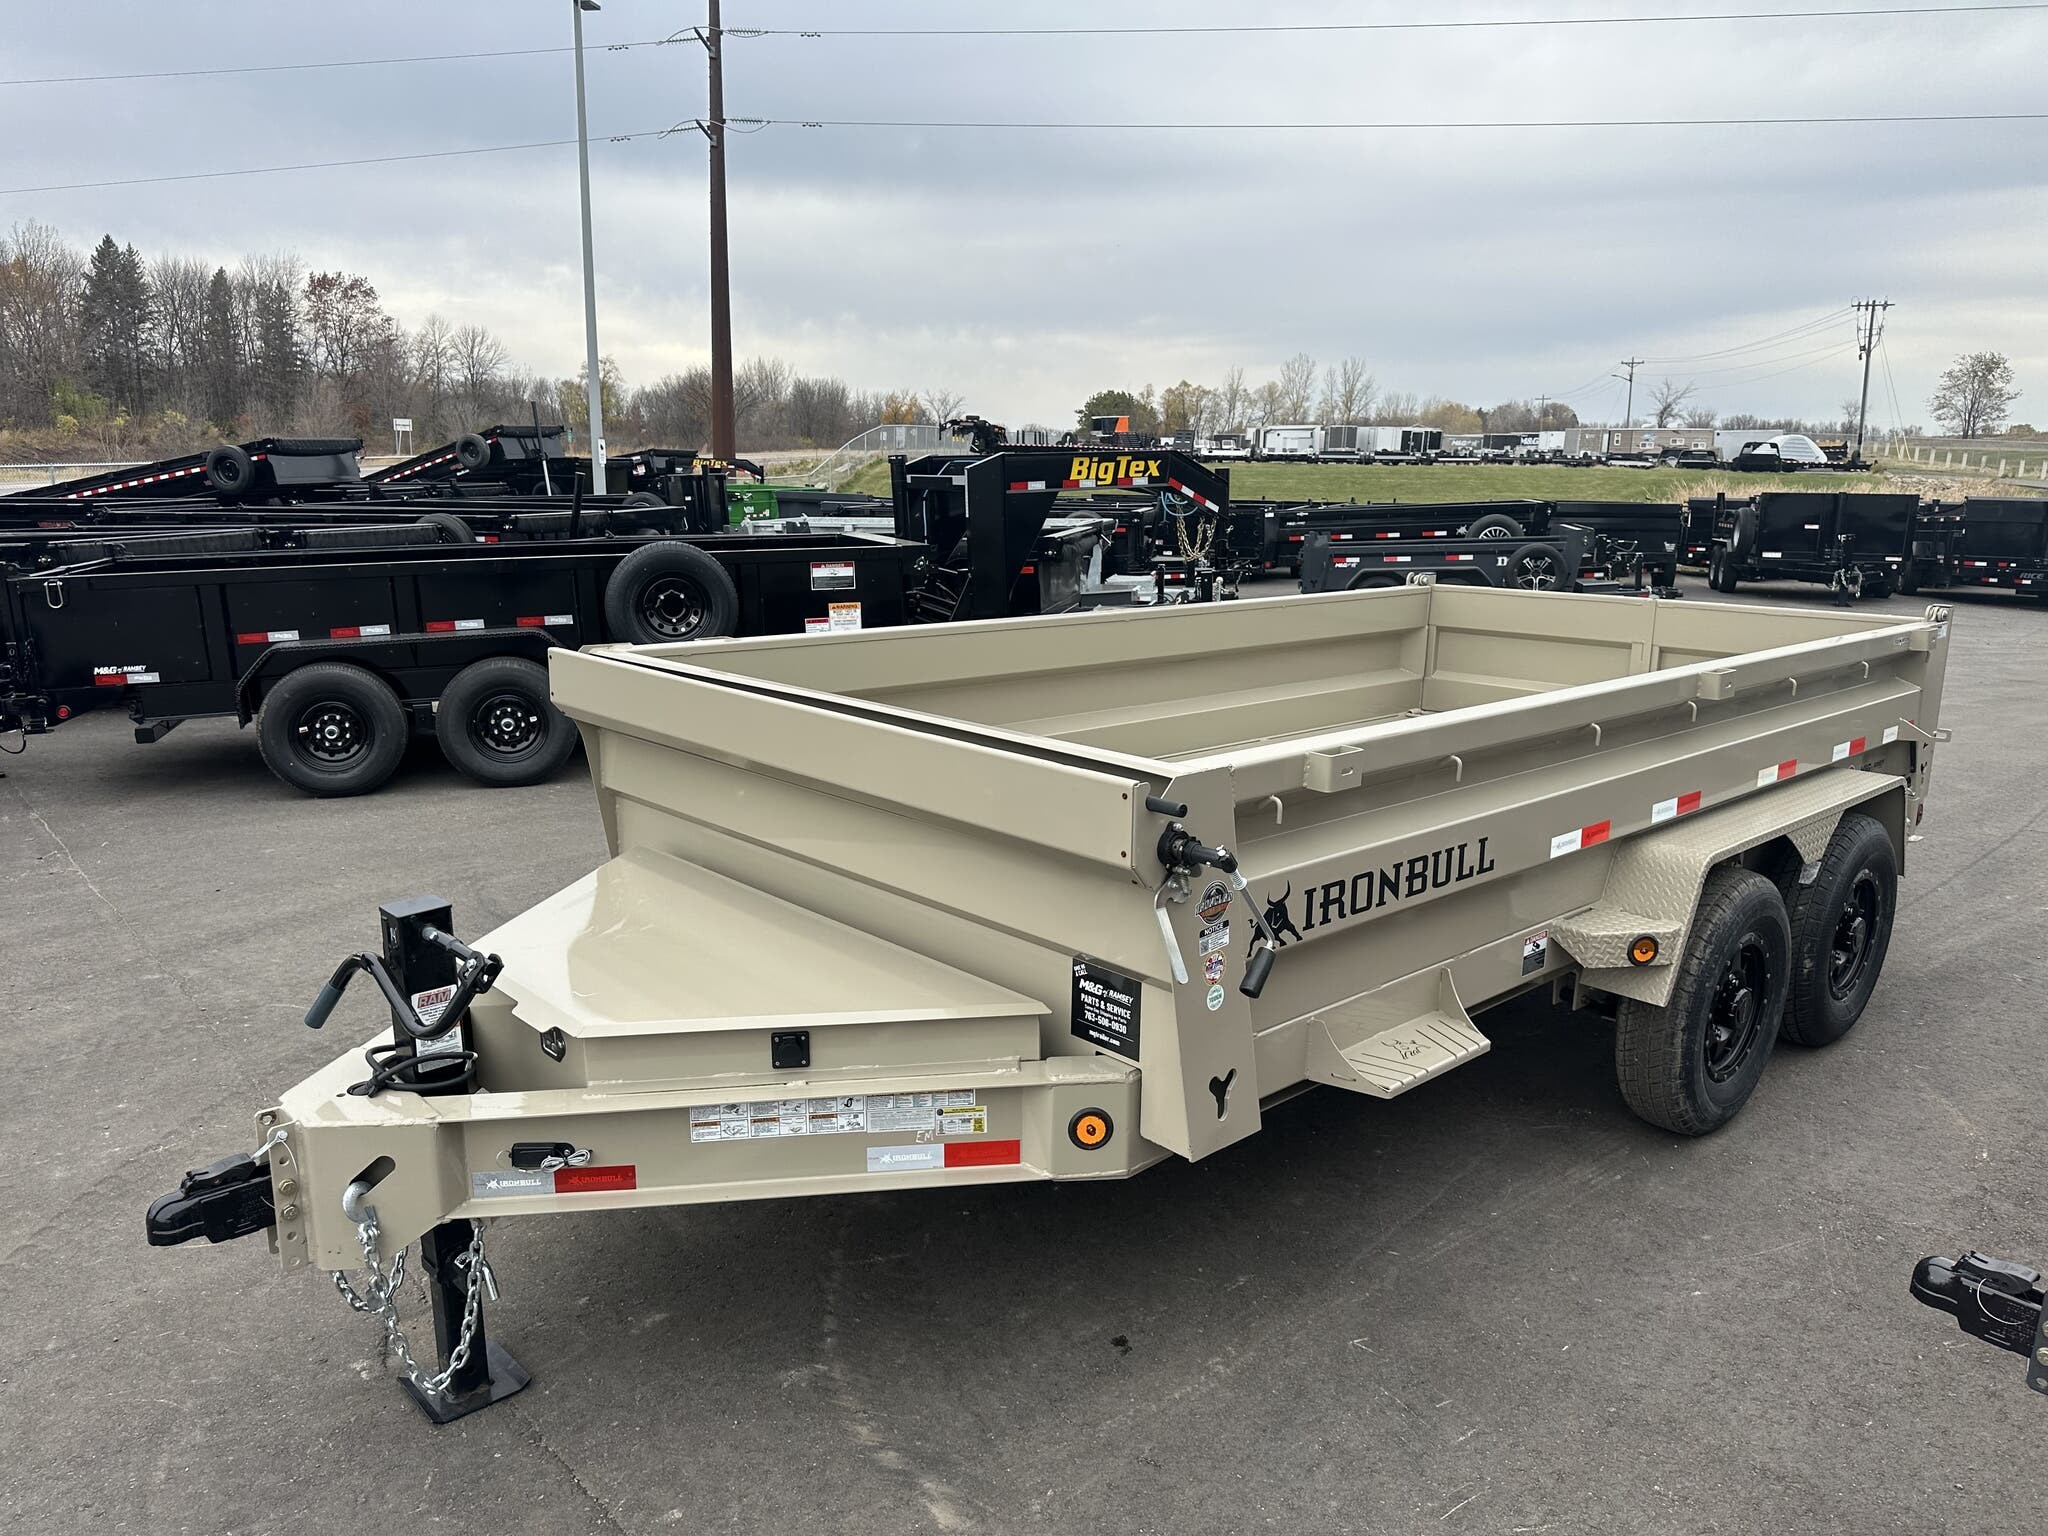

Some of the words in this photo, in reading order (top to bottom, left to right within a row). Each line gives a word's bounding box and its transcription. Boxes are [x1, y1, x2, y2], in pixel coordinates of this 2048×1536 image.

[1070, 455, 1161, 485] BigTex
[94, 666, 117, 675] M&G
[1302, 836, 1495, 932] IRONBULL
[1204, 921, 1224, 936] NOTICE
[417, 990, 452, 1008] RAM
[1079, 978, 1104, 996] M&G
[1109, 989, 1134, 1004] RAMSEY
[1081, 993, 1100, 1008] PARTS
[1100, 1000, 1106, 1010] &
[1106, 1002, 1132, 1020] SERVICE
[892, 1152, 933, 1162] IRONBULL
[499, 1178, 542, 1188] IRONBULL
[581, 1175, 623, 1184] IRONBULL
